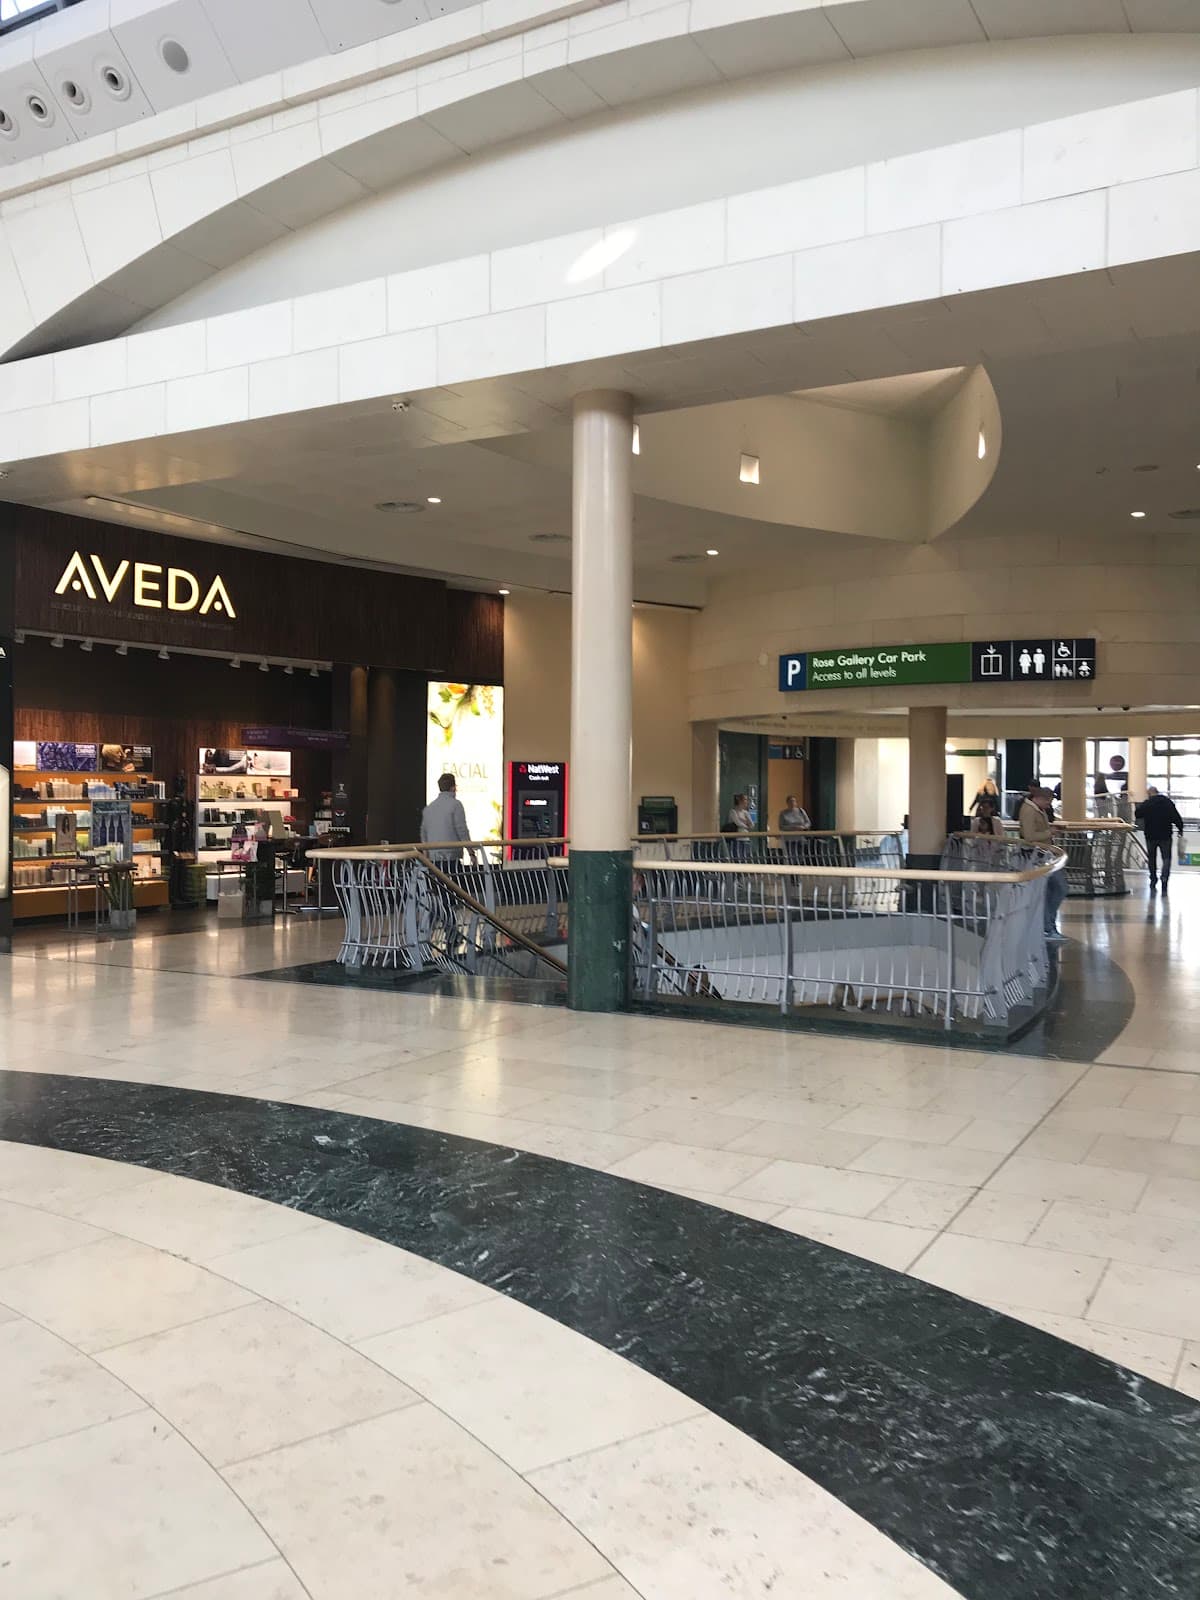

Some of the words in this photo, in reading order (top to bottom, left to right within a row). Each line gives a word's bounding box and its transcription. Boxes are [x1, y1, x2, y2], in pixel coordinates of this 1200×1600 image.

[54, 550, 237, 619] AVEDA
[812, 657, 834, 668] Rose
[836, 654, 875, 667] Gallery
[877, 652, 898, 664] Car
[901, 650, 927, 662] Park
[787, 659, 801, 686] P
[812, 671, 841, 682] Access
[844, 669, 853, 679] to
[855, 668, 867, 679] all
[870, 666, 896, 679] levels
[443, 763, 488, 779] FACIAL
[527, 764, 560, 774] NatWest
